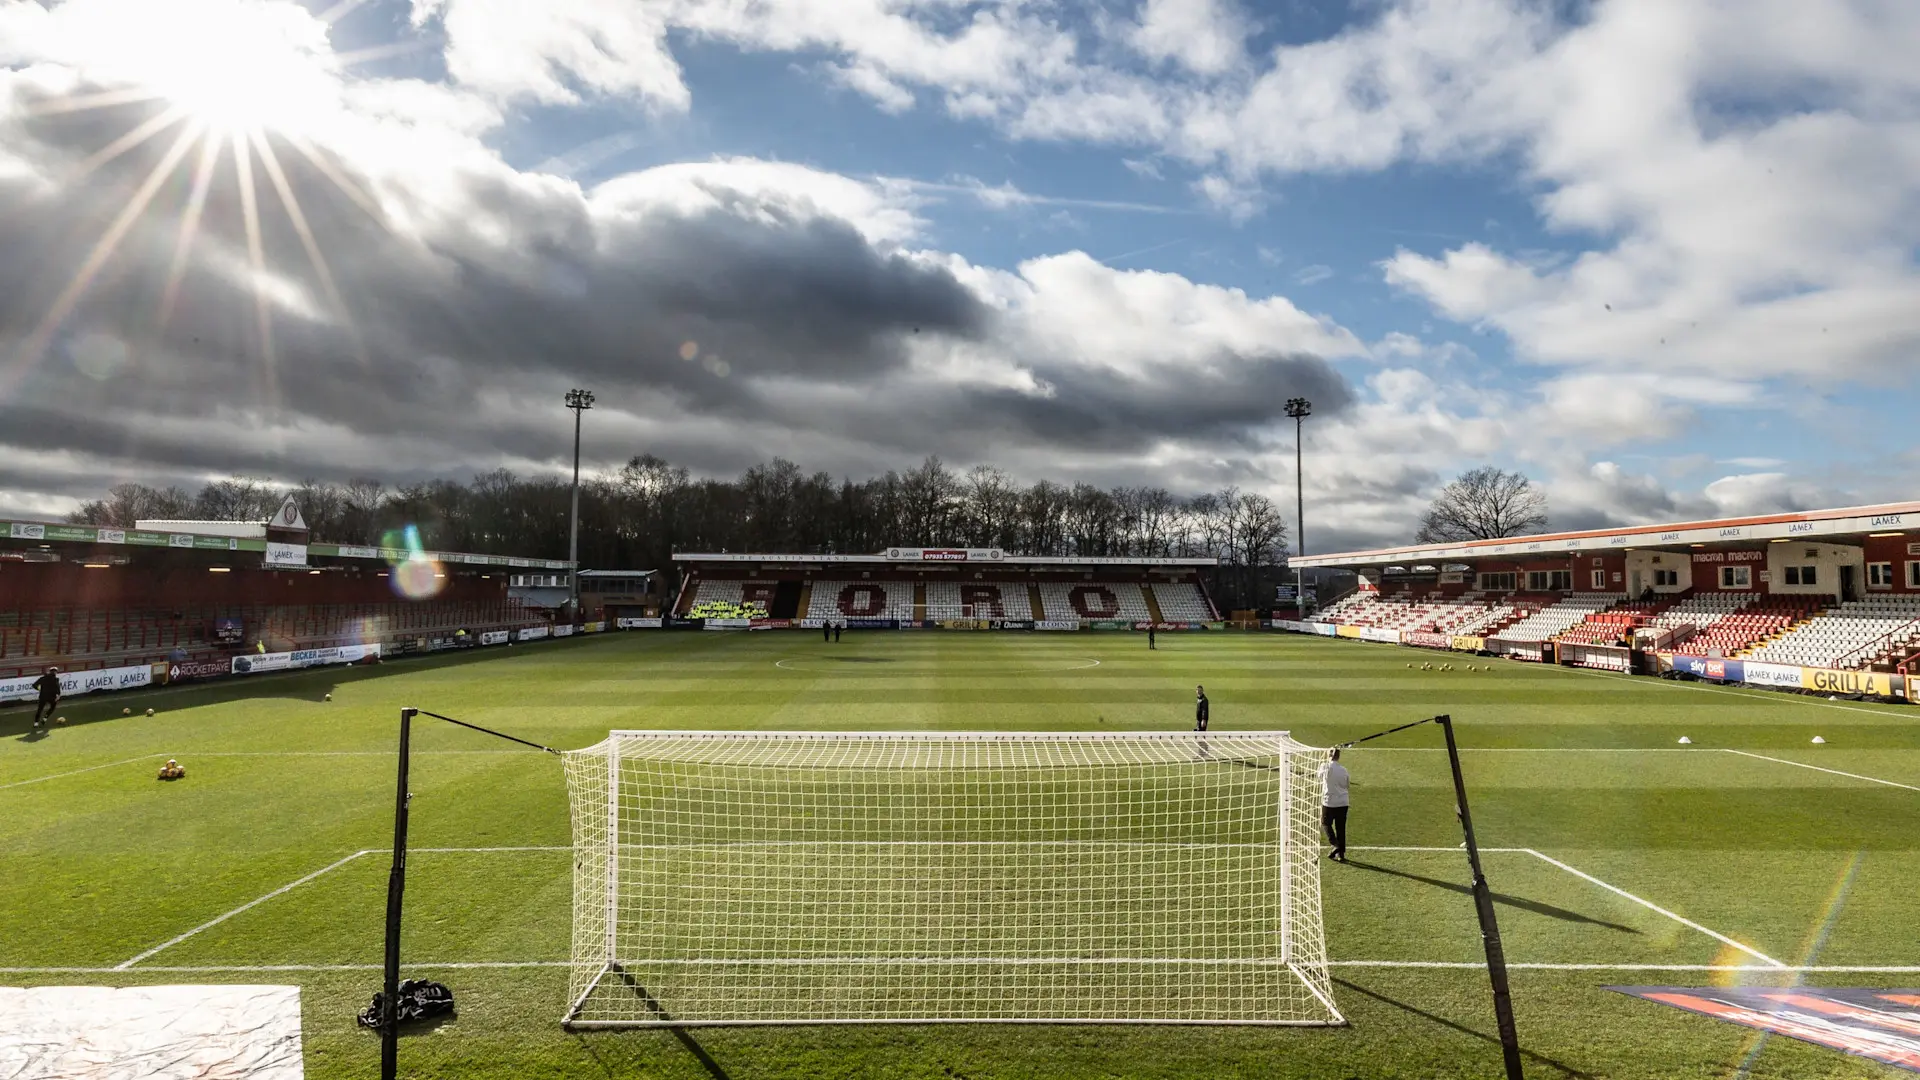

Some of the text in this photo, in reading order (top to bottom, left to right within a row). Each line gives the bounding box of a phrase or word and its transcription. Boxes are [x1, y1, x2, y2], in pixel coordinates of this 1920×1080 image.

[1871, 515, 1901, 526] LAMEX
[1719, 528, 1740, 537] LAMEX
[1788, 522, 1814, 533] LAMEX
[1611, 537, 1627, 545] LAMEX
[1661, 532, 1680, 541] LAMEX
[274, 551, 293, 560] LAMEX
[1693, 551, 1762, 563] macron macron
[290, 650, 318, 661] BECKER
[180, 661, 230, 676] ROCKETPAYE
[1690, 659, 1723, 674] sky bet
[85, 676, 114, 689] LAMEX
[120, 672, 147, 685] LAMEX
[1746, 669, 1800, 683] LAMEX LAMEX
